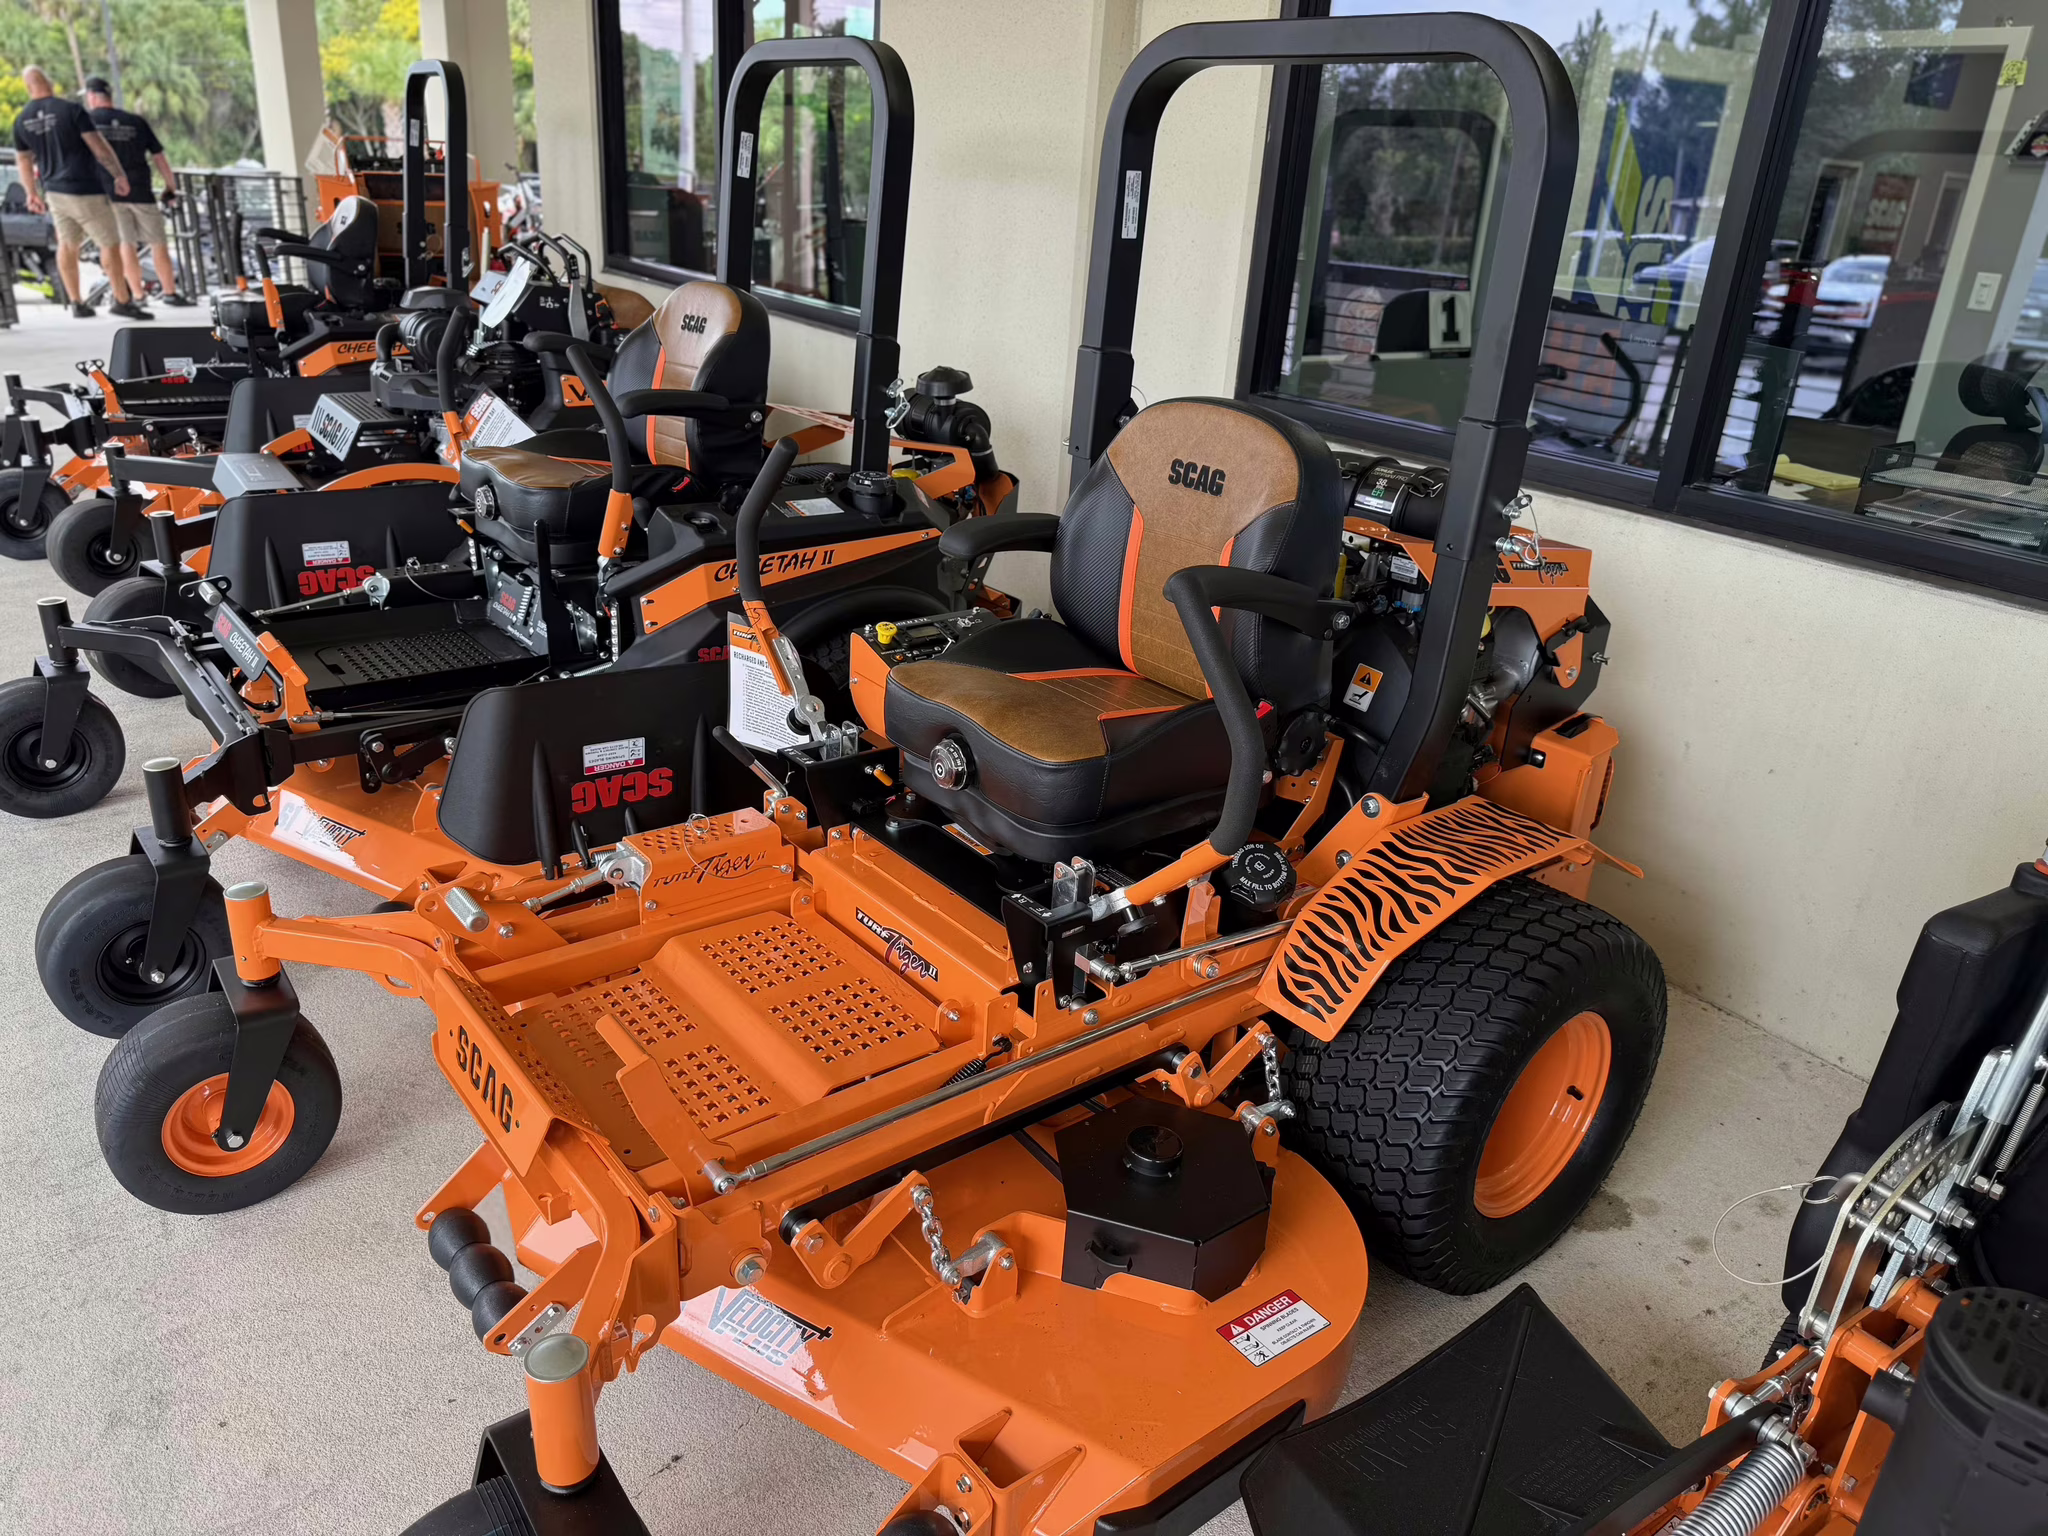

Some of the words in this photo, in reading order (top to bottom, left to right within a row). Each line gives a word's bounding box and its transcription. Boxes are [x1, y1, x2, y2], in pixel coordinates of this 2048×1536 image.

[681, 313, 708, 335] SCAG
[337, 341, 402, 354] CHEEH
[319, 412, 343, 446] SCAG
[1168, 458, 1226, 497] SCAG
[821, 549, 835, 566] II
[297, 565, 375, 596] SCAG
[229, 631, 255, 664] CHEETAH
[698, 645, 730, 662] SCA
[594, 760, 626, 772] DANGER
[571, 767, 673, 814] SCAG
[1239, 876, 1252, 886] MAX
[1272, 871, 1288, 889] BOTTOM
[857, 910, 891, 939] TURF
[928, 965, 938, 979] II
[455, 1024, 514, 1134] SCAG
[708, 1286, 817, 1355] VELOCITY
[1243, 1295, 1293, 1327] DANGER
[1260, 1317, 1282, 1331] SPINNING
[1280, 1307, 1299, 1320] BLADES
[1272, 1337, 1284, 1345] BLADE
[1282, 1327, 1300, 1340] CONTACT
[1302, 1318, 1317, 1328] THROWN
[1276, 1324, 1287, 1332] KEEP
[1285, 1318, 1298, 1327] CLEAR
[1280, 1334, 1297, 1346] OBJECTS
[1302, 1324, 1315, 1334] INJURE
